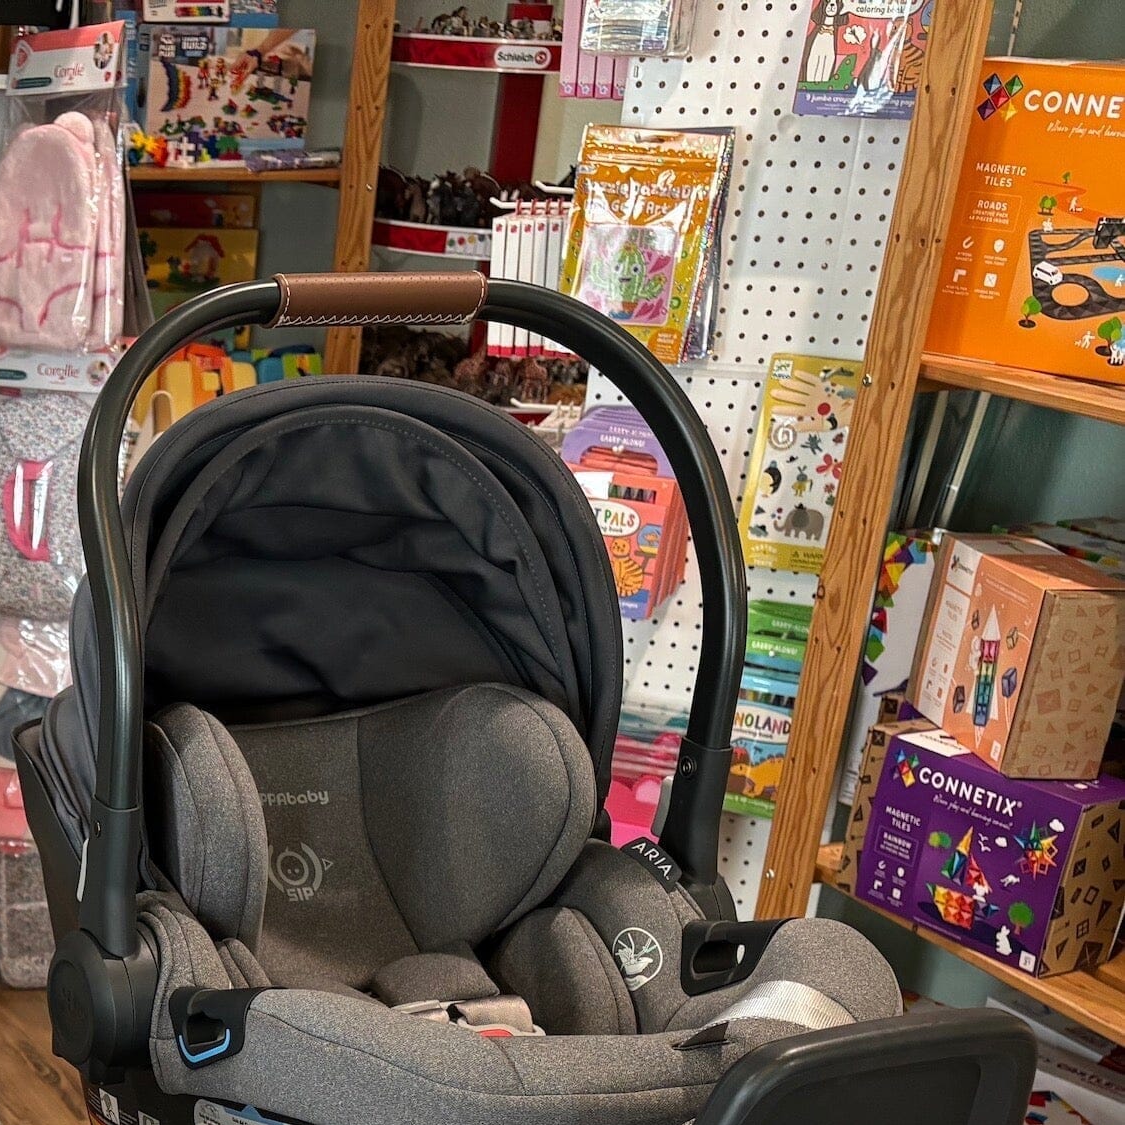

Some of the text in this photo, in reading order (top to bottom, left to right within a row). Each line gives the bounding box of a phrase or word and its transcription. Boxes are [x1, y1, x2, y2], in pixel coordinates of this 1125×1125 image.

[497, 51, 534, 64] Schleich
[1024, 89, 1125, 119] CONNE
[976, 162, 1027, 177] MAGNETIC
[984, 175, 1013, 188] TILES
[977, 199, 1008, 211] ROADS
[604, 509, 635, 527] PALS
[734, 711, 791, 735] NOLAND
[259, 789, 329, 806] PPAbaby
[885, 805, 921, 828] MAGNETIC
[892, 818, 911, 833] TILES
[286, 886, 314, 901] SIP
